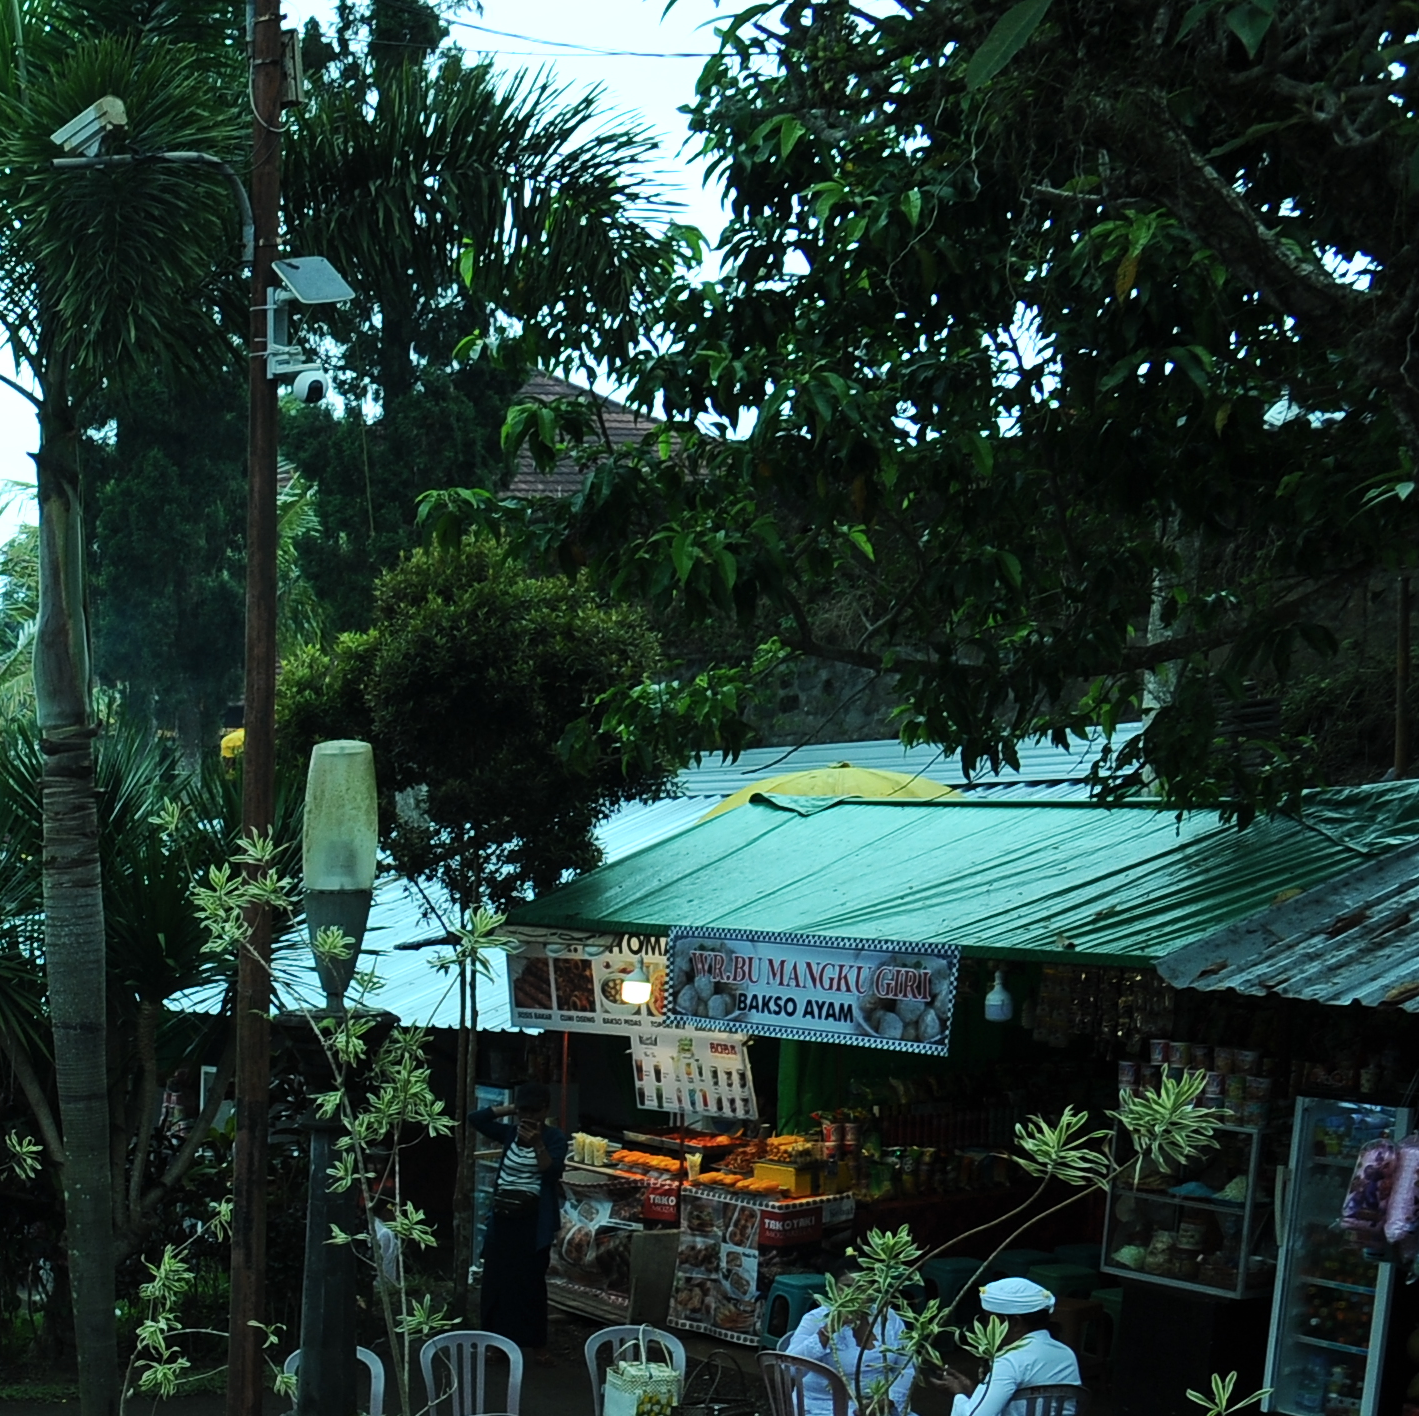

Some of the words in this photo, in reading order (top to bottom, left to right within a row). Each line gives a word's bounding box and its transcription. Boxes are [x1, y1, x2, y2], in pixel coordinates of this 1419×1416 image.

[690, 951, 763, 984] WR.BU
[766, 957, 873, 995] MANGKU
[874, 966, 932, 1002] GIRI
[736, 992, 798, 1018] BAKSO
[802, 1001, 855, 1024] AYAM
[603, 1017, 623, 1026] BAKSO
[649, 1194, 676, 1206] TAKO
[763, 1215, 816, 1231] TAKOYAKI
